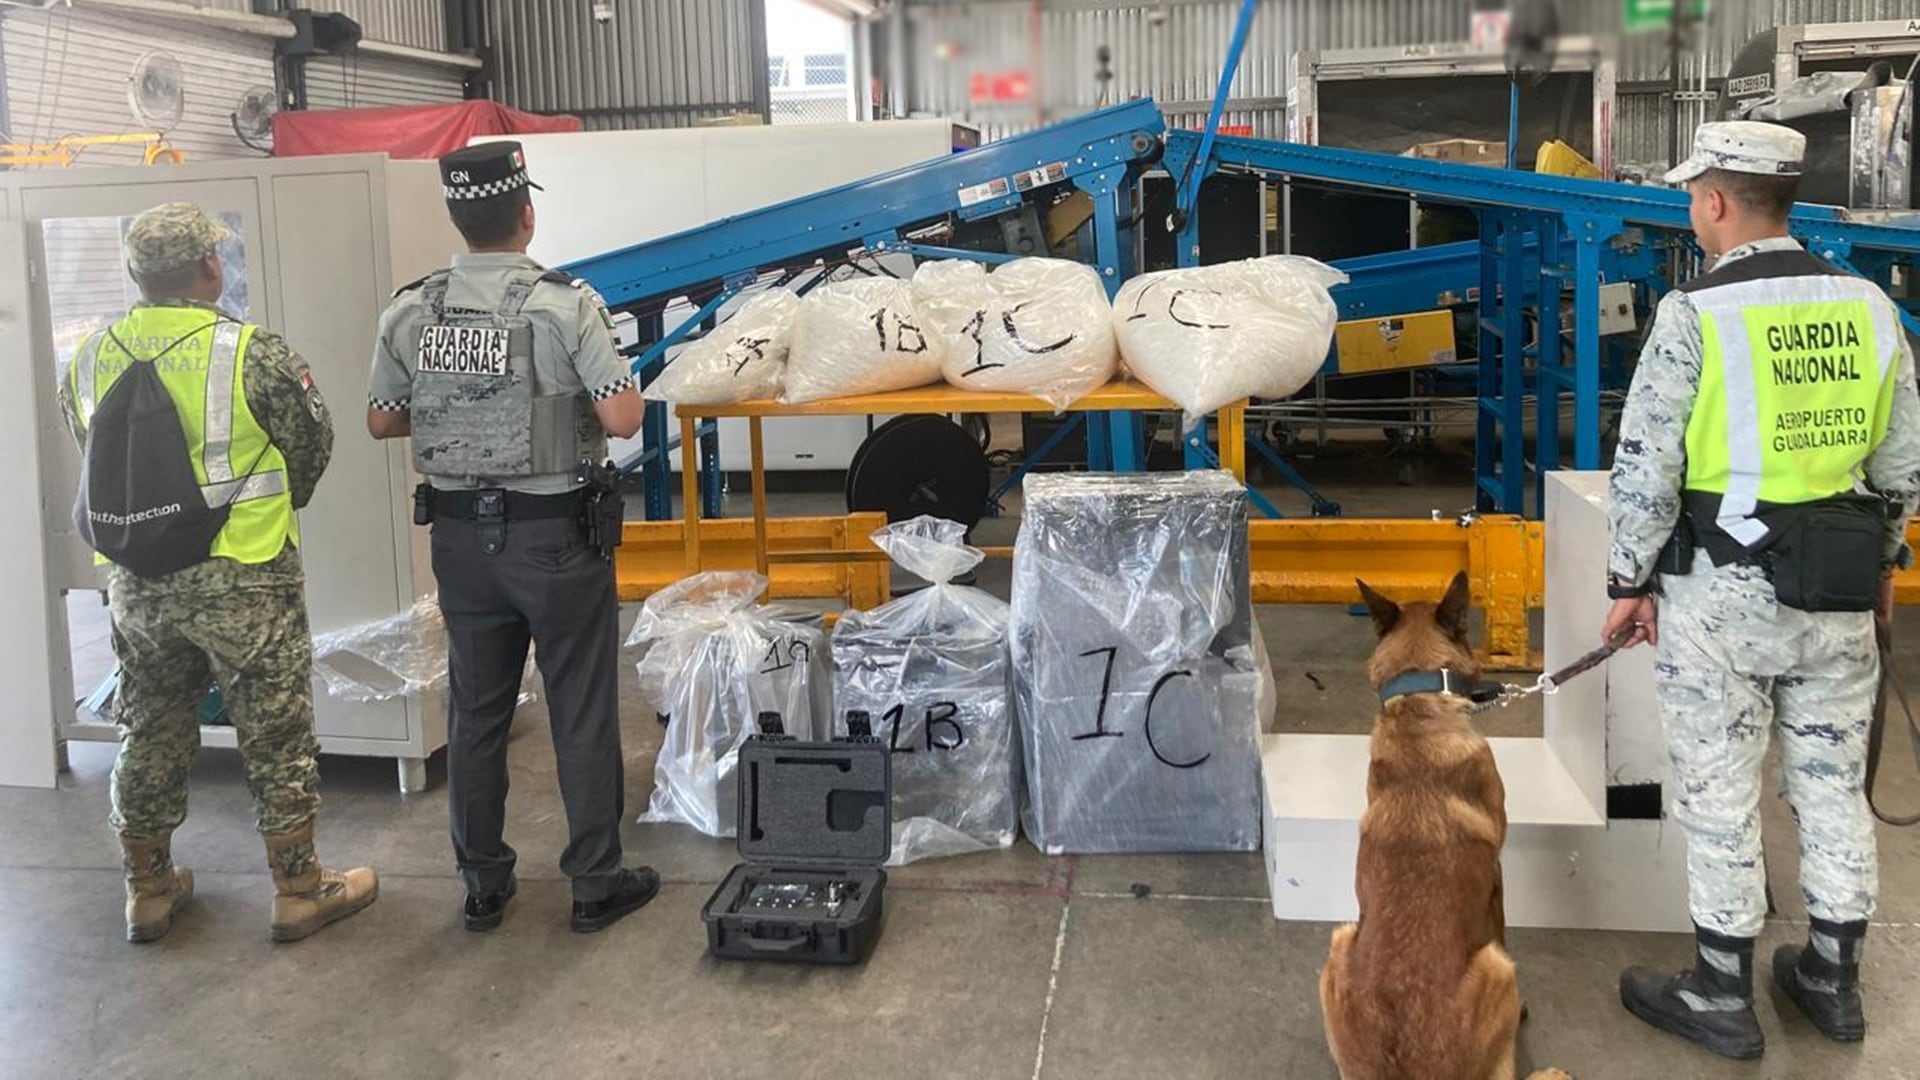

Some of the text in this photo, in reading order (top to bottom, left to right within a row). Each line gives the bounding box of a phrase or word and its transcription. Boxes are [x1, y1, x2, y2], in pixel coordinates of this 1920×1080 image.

[450, 170, 470, 184] GN
[423, 327, 501, 352] GUARDIA
[1767, 320, 1860, 352] GUARDIA
[422, 349, 500, 373] NACIONAL
[1772, 353, 1861, 386] NACIONAL
[1775, 407, 1866, 431] AEROPUERTO
[882, 701, 963, 753] 1B
